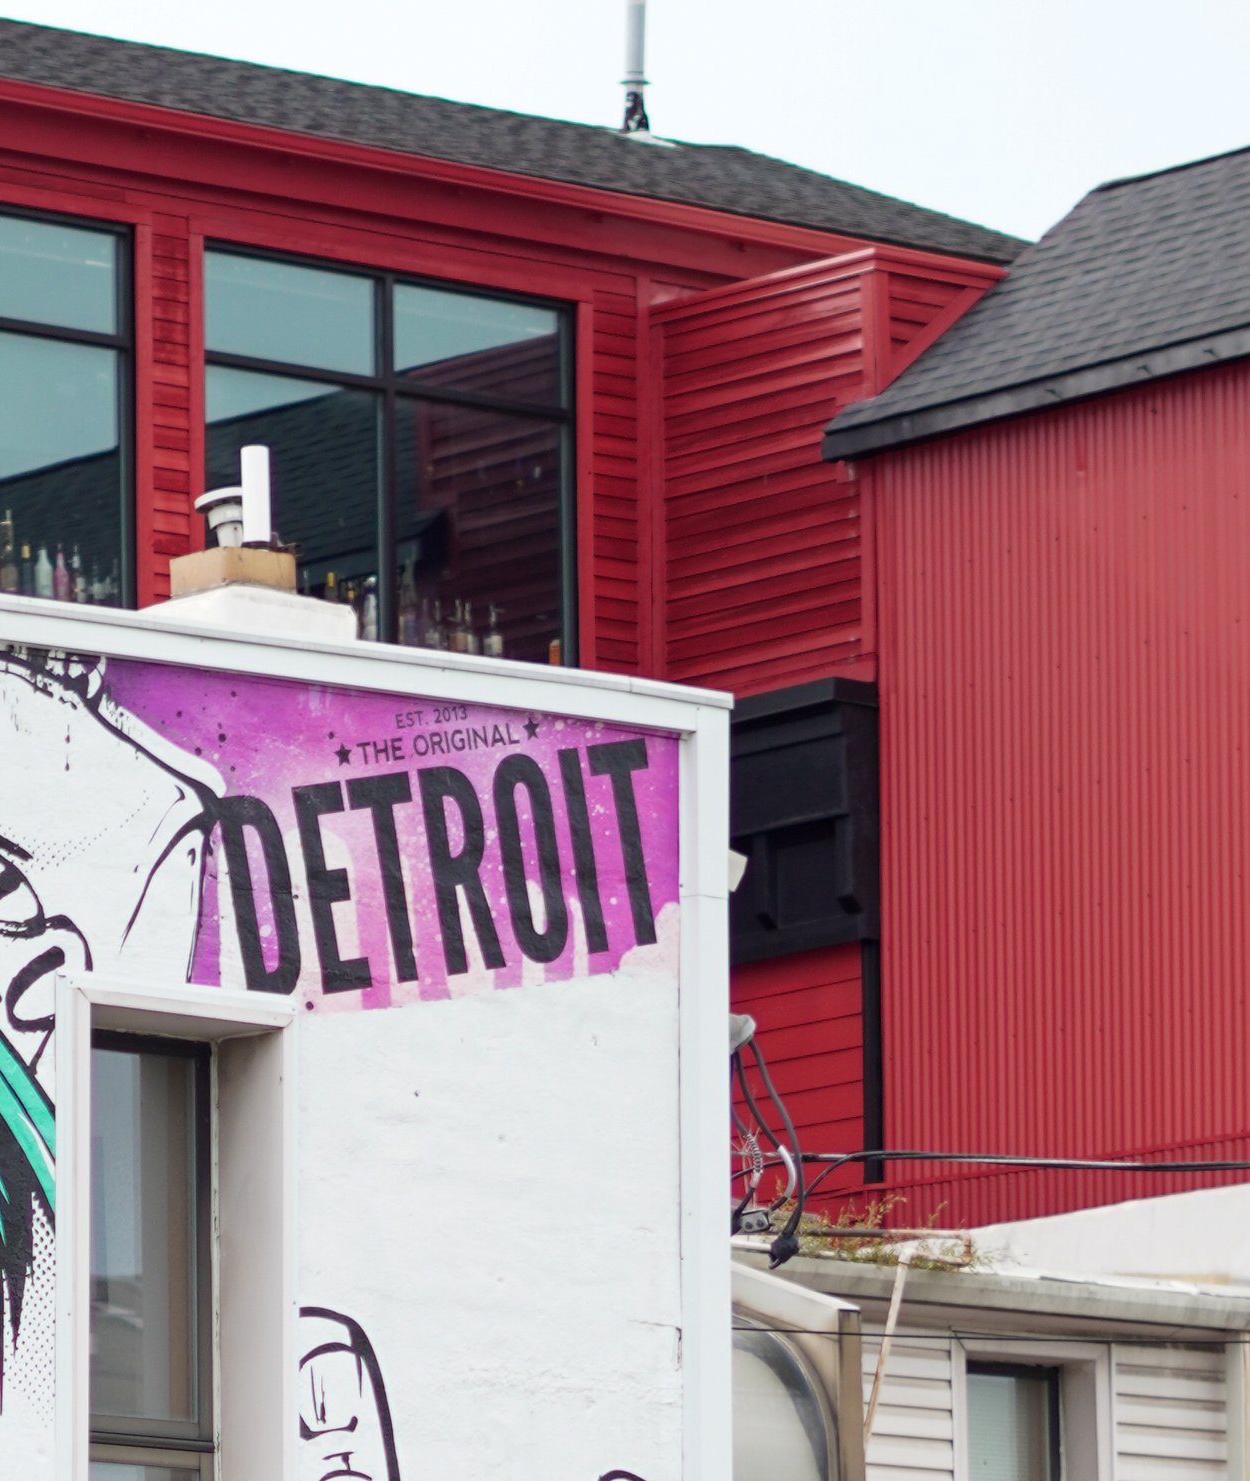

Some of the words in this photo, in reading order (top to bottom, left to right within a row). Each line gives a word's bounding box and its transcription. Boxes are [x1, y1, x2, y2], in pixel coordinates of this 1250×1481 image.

[395, 710, 429, 729] EST.
[434, 704, 469, 725] 2013
[356, 737, 406, 765] THE
[413, 722, 521, 757] ORIGINAL
[219, 738, 658, 996] DETROIT
